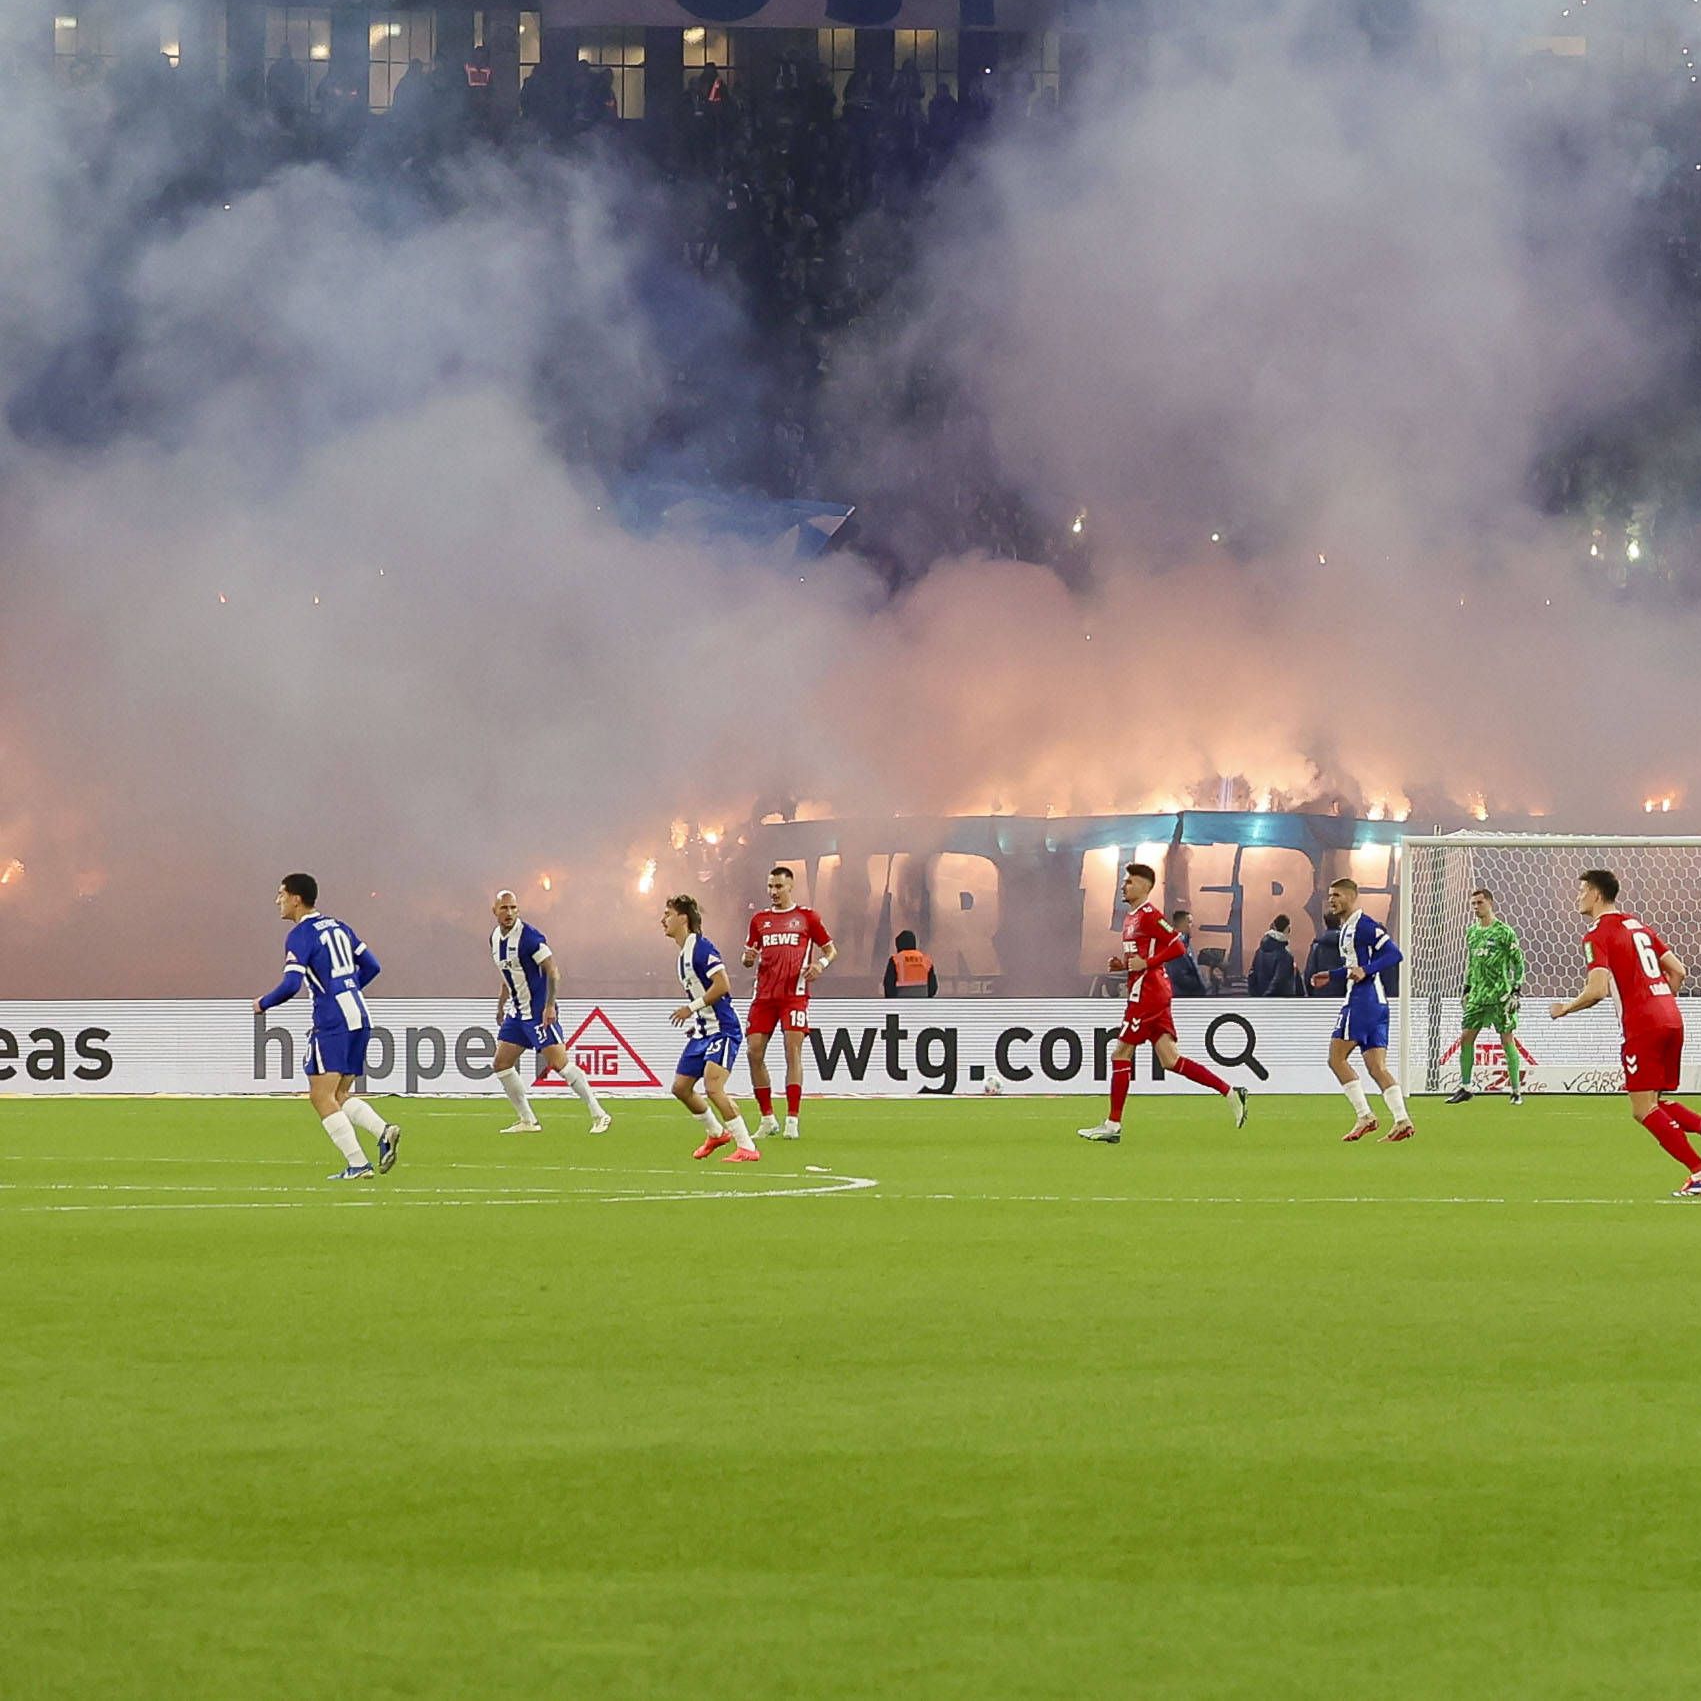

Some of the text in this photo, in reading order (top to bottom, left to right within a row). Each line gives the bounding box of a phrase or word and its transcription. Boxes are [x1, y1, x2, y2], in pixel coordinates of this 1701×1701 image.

[1080, 842, 1402, 980] LIEBE
[319, 928, 356, 979] 10
[762, 933, 800, 947] REWE
[1632, 932, 1662, 979] 6
[790, 1010, 806, 1027] 19
[254, 1011, 549, 1094] hppe
[575, 1045, 619, 1075] WTG
